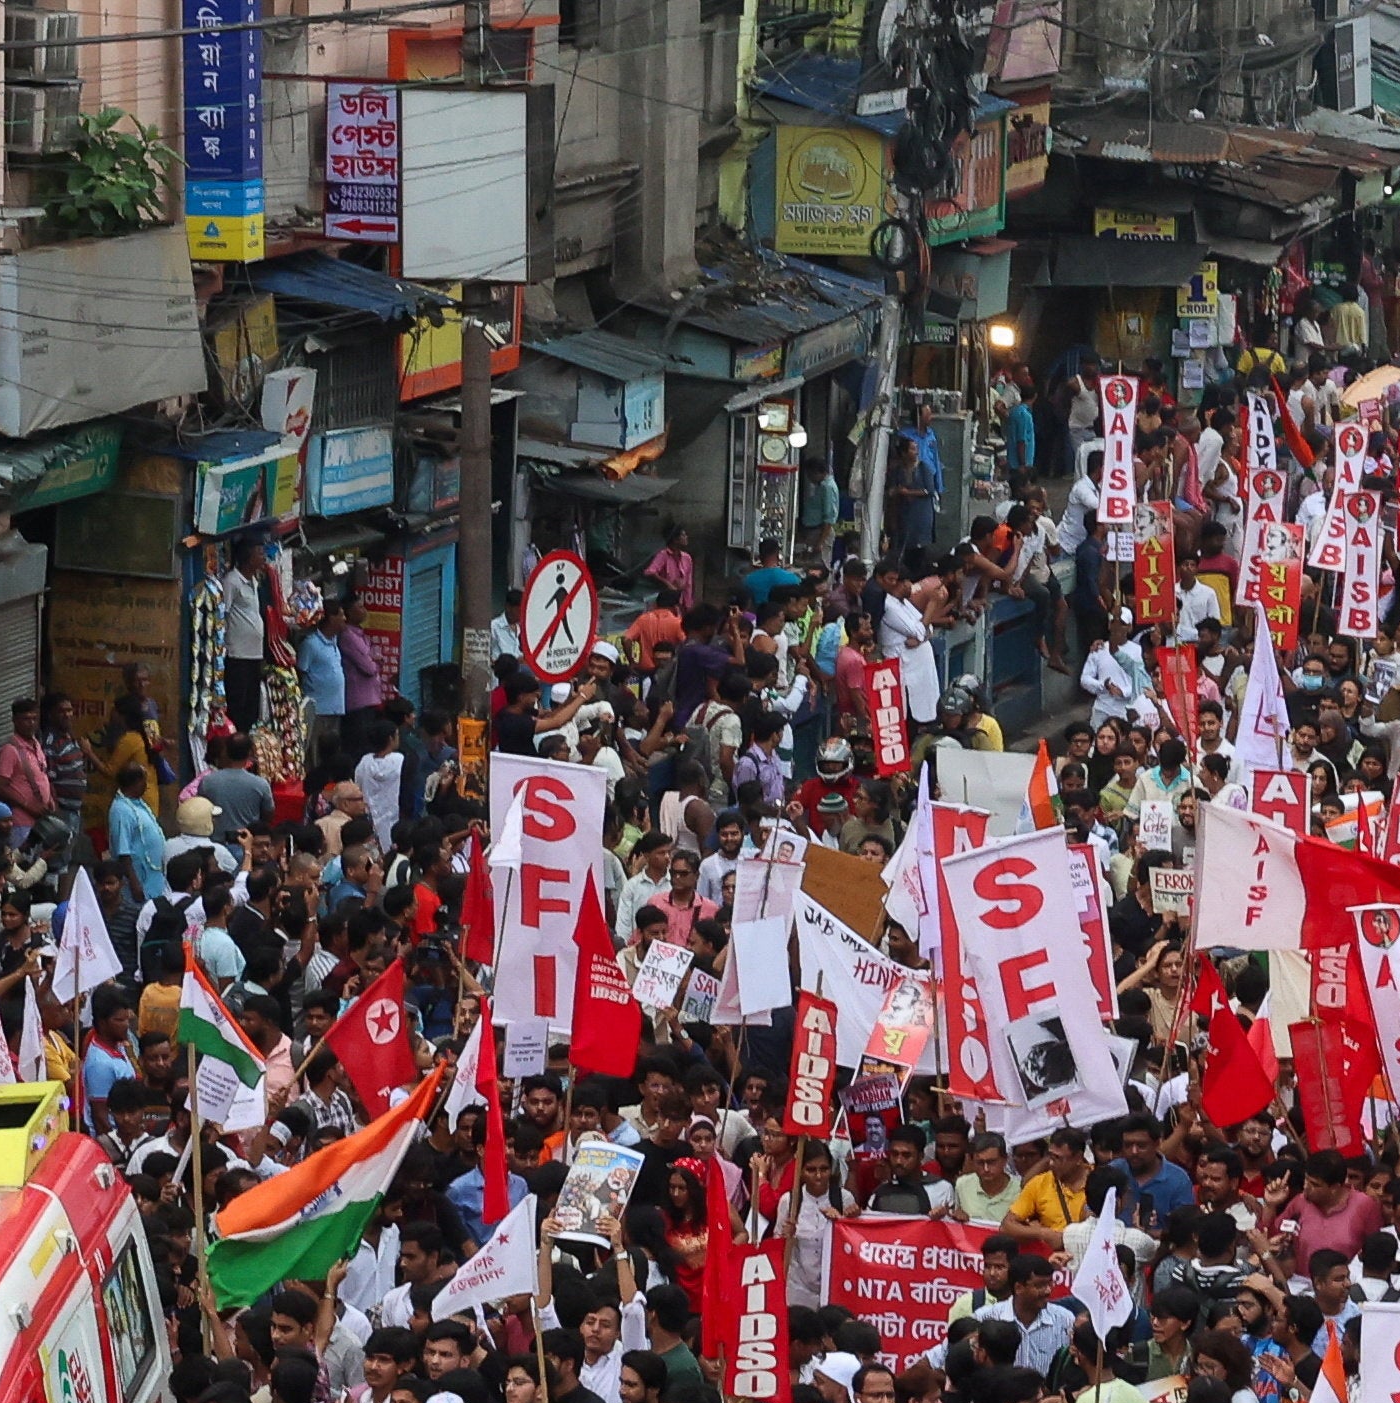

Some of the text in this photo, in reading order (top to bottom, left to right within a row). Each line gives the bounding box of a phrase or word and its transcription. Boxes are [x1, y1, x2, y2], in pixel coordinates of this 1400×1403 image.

[332, 122, 396, 147] গেস্ট
[340, 89, 388, 121] ডলি
[332, 150, 396, 181] হাউস
[1178, 304, 1215, 316] CRORE
[1108, 417, 1131, 518] AISB
[1318, 466, 1354, 567] AISB
[1140, 536, 1163, 618] AIYL
[1350, 531, 1372, 632] AISB
[873, 668, 905, 765] AIDSO
[513, 775, 576, 1018] SFI
[804, 904, 835, 936] JAB
[793, 1006, 830, 1127] AIDSO
[857, 1279, 903, 1301] NTA
[858, 1240, 917, 1271] ধর্মেন্দ্র
[735, 1254, 780, 1399] AIDSO
